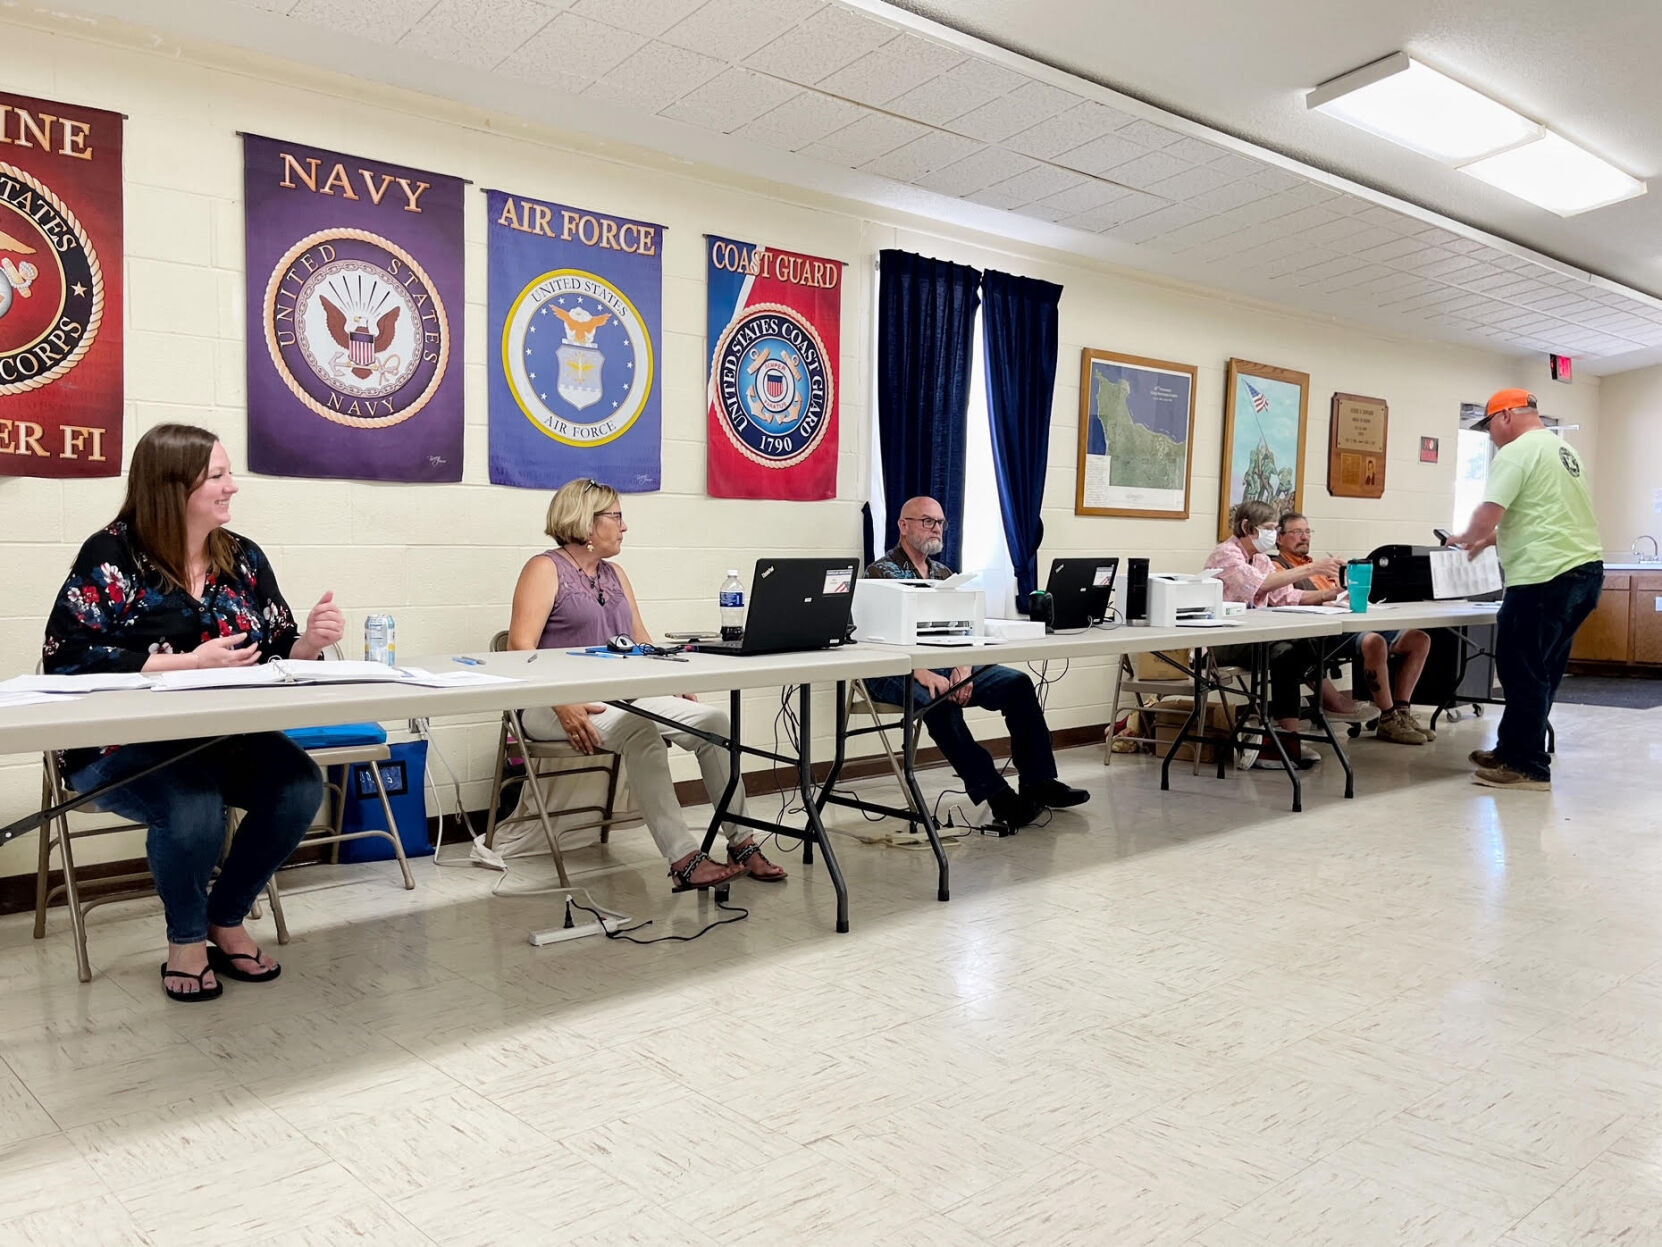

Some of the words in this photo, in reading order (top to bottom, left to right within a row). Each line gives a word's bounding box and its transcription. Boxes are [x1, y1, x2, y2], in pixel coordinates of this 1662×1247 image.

[279, 152, 431, 213] NAVY
[498, 197, 556, 238] AIR
[561, 210, 656, 256] FORCE
[712, 240, 773, 278] COAST
[775, 254, 838, 289] GUARD
[276, 244, 337, 347] UNITED
[387, 257, 440, 365] STATES
[531, 277, 581, 304] UNITED
[584, 282, 629, 318] STATES
[0, 316, 82, 380] CORPS
[731, 318, 779, 358] STATES
[781, 321, 820, 374] COAST
[326, 391, 395, 416] NAVY
[723, 355, 748, 433] UNITED
[799, 375, 824, 438] GUARD
[59, 424, 106, 461] FI
[544, 415, 568, 436] AIR
[573, 420, 617, 439] FORCE
[759, 436, 793, 453] 1790
